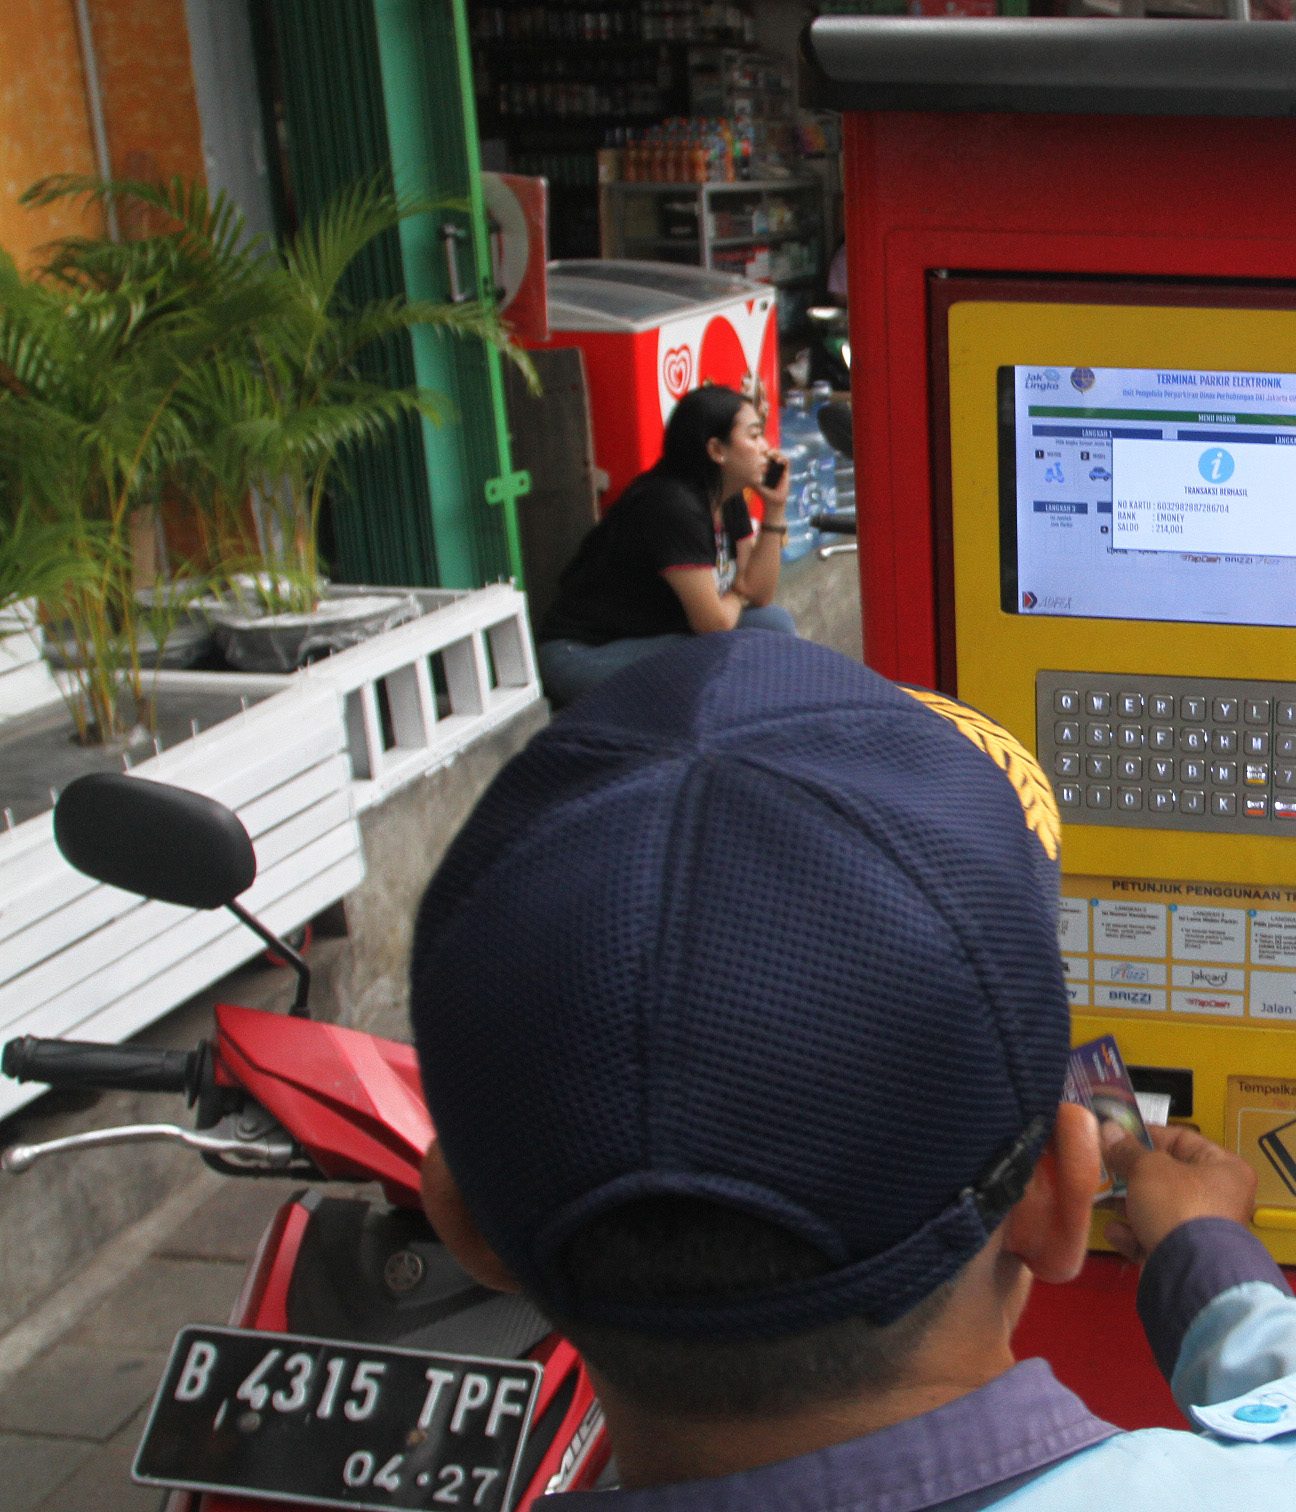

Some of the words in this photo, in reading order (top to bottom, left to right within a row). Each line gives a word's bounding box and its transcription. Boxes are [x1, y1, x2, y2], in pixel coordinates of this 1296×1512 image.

[1157, 374, 1197, 386] TERMINAL
[1200, 376, 1229, 388] PARKIR
[1233, 377, 1282, 389] ELEKTRONIK
[1198, 414, 1214, 422] MENU
[1216, 415, 1236, 424] PARKIR
[1082, 429, 1108, 438] LANGKAH
[1184, 486, 1218, 495] TRANSAKSI
[1220, 488, 1248, 497] BERHASIL
[1045, 504, 1071, 512] LANGKAH
[1117, 501, 1127, 509] NO
[1129, 501, 1151, 510] KARTU
[1117, 511, 1136, 520] BANK
[1157, 513, 1184, 522] EMONEY
[1117, 522, 1139, 532] SALDO
[1061, 695, 1072, 709] Q
[1092, 696, 1103, 711] W
[1125, 698, 1134, 712] E
[1156, 700, 1166, 713] R
[1189, 702, 1198, 715] T
[1221, 703, 1230, 716] Y
[1252, 705, 1261, 718] L
[1062, 727, 1072, 740] A
[1094, 728, 1103, 742] S
[1125, 730, 1134, 743] D
[1157, 732, 1166, 745] F
[1188, 733, 1198, 747] G
[1220, 735, 1230, 749] H
[1252, 737, 1262, 750] M
[1062, 758, 1071, 772] Z
[1093, 760, 1103, 773] X
[1125, 761, 1134, 775] C
[1157, 763, 1166, 776] V
[1188, 764, 1197, 778] B
[1219, 767, 1229, 781] N
[1284, 770, 1292, 784] 7
[1063, 788, 1072, 801] U
[1157, 794, 1166, 808] P
[1188, 796, 1197, 809] J
[1219, 798, 1228, 811] K
[1112, 880, 1182, 895] PETUNJUK
[1186, 885, 1281, 901] PENGGUNAAN
[1109, 991, 1151, 1004] BRIZZI
[1260, 1002, 1292, 1016] Jalan
[173, 1341, 218, 1401] B
[237, 1348, 387, 1422] 4315
[417, 1367, 529, 1438] TPF
